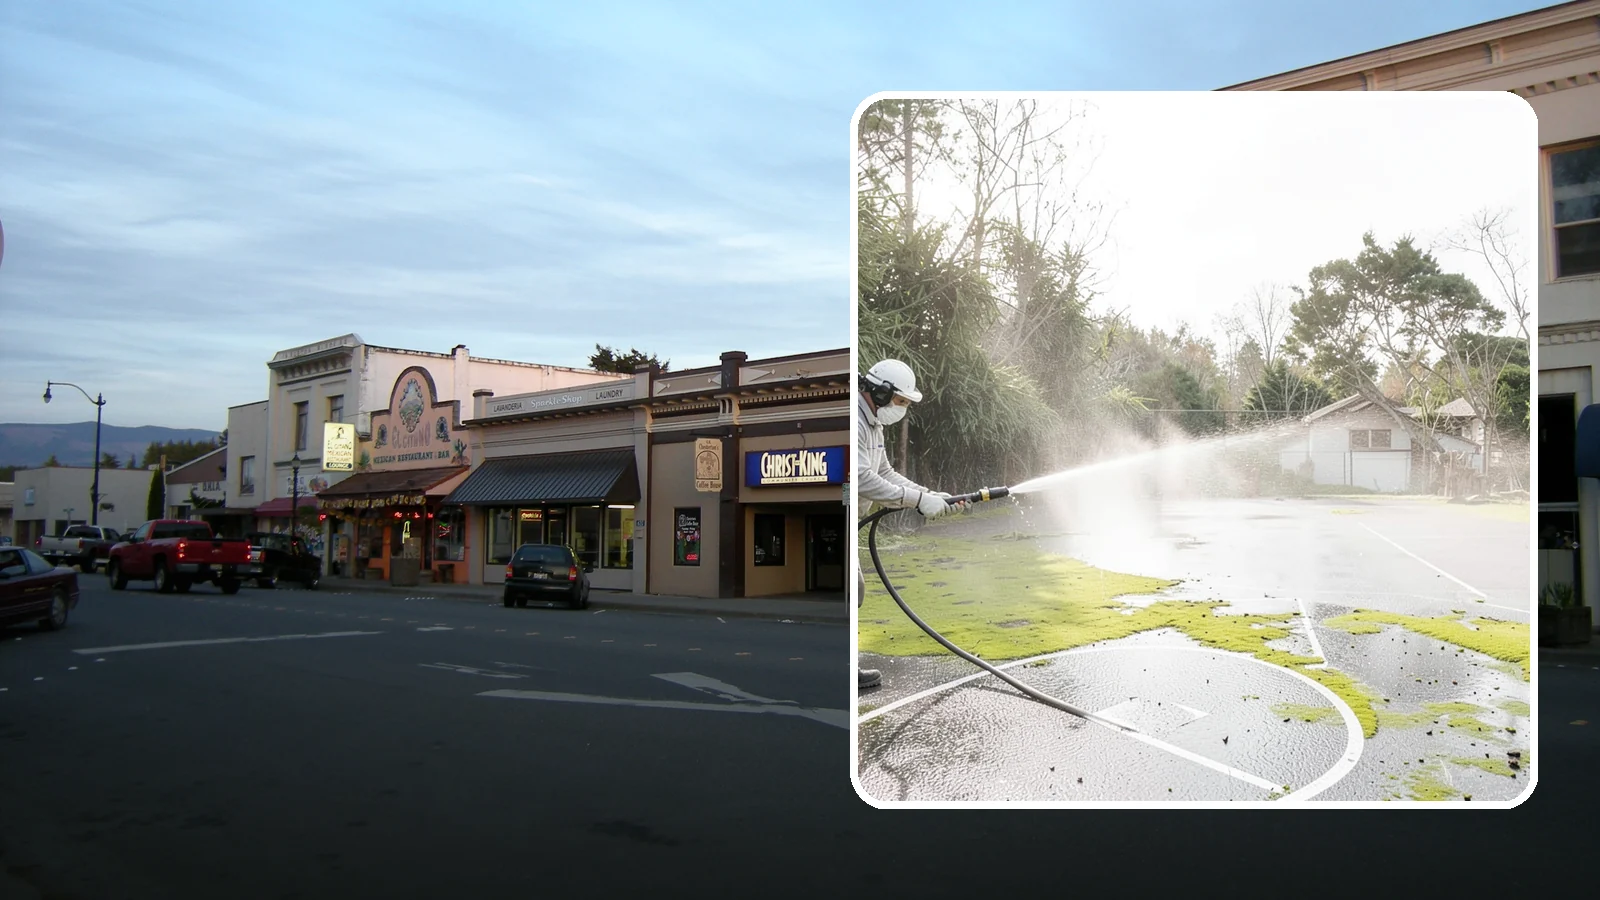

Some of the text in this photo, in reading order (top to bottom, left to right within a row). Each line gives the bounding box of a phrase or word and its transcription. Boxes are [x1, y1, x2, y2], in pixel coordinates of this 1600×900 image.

[562, 395, 582, 405] Shop
[595, 389, 623, 400] LAUNDRY
[493, 402, 522, 412] LAVANDERIA
[374, 455, 396, 463] MEXICAN
[398, 452, 433, 462] RESTAURANT
[438, 450, 450, 459] BAR
[760, 450, 827, 478] CHRIST KING
